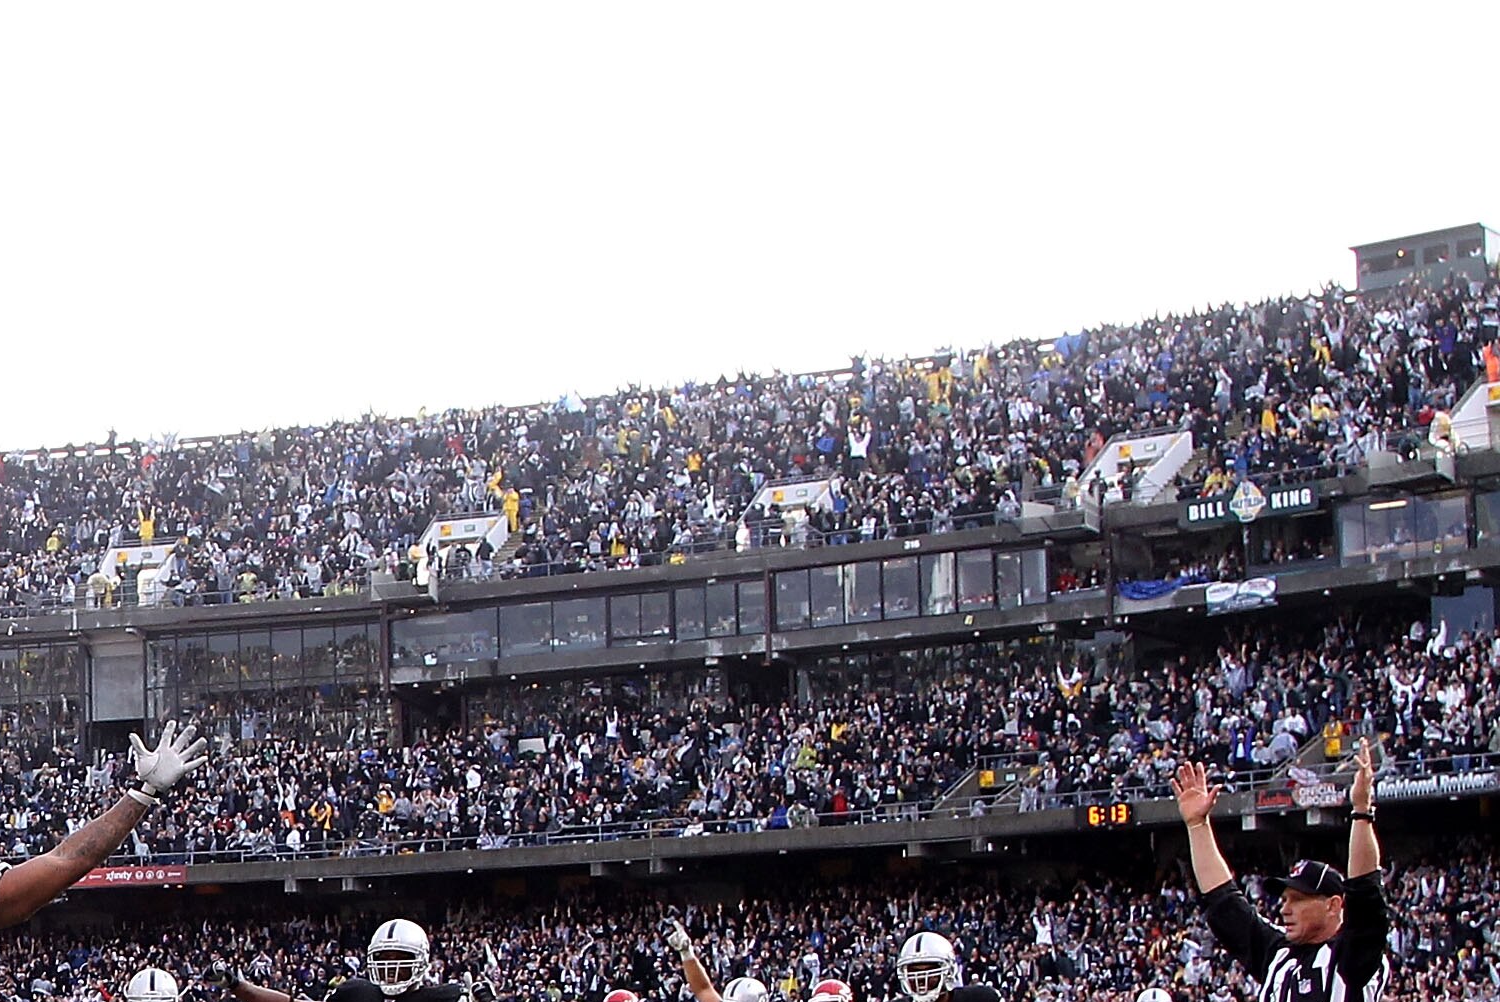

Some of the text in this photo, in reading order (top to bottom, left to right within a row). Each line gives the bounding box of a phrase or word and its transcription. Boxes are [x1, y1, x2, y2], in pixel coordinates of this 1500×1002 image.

[1188, 501, 1225, 521] BILL
[1271, 488, 1311, 509] KING
[1089, 804, 1126, 825] 6:13
[106, 871, 132, 881] xfinity
